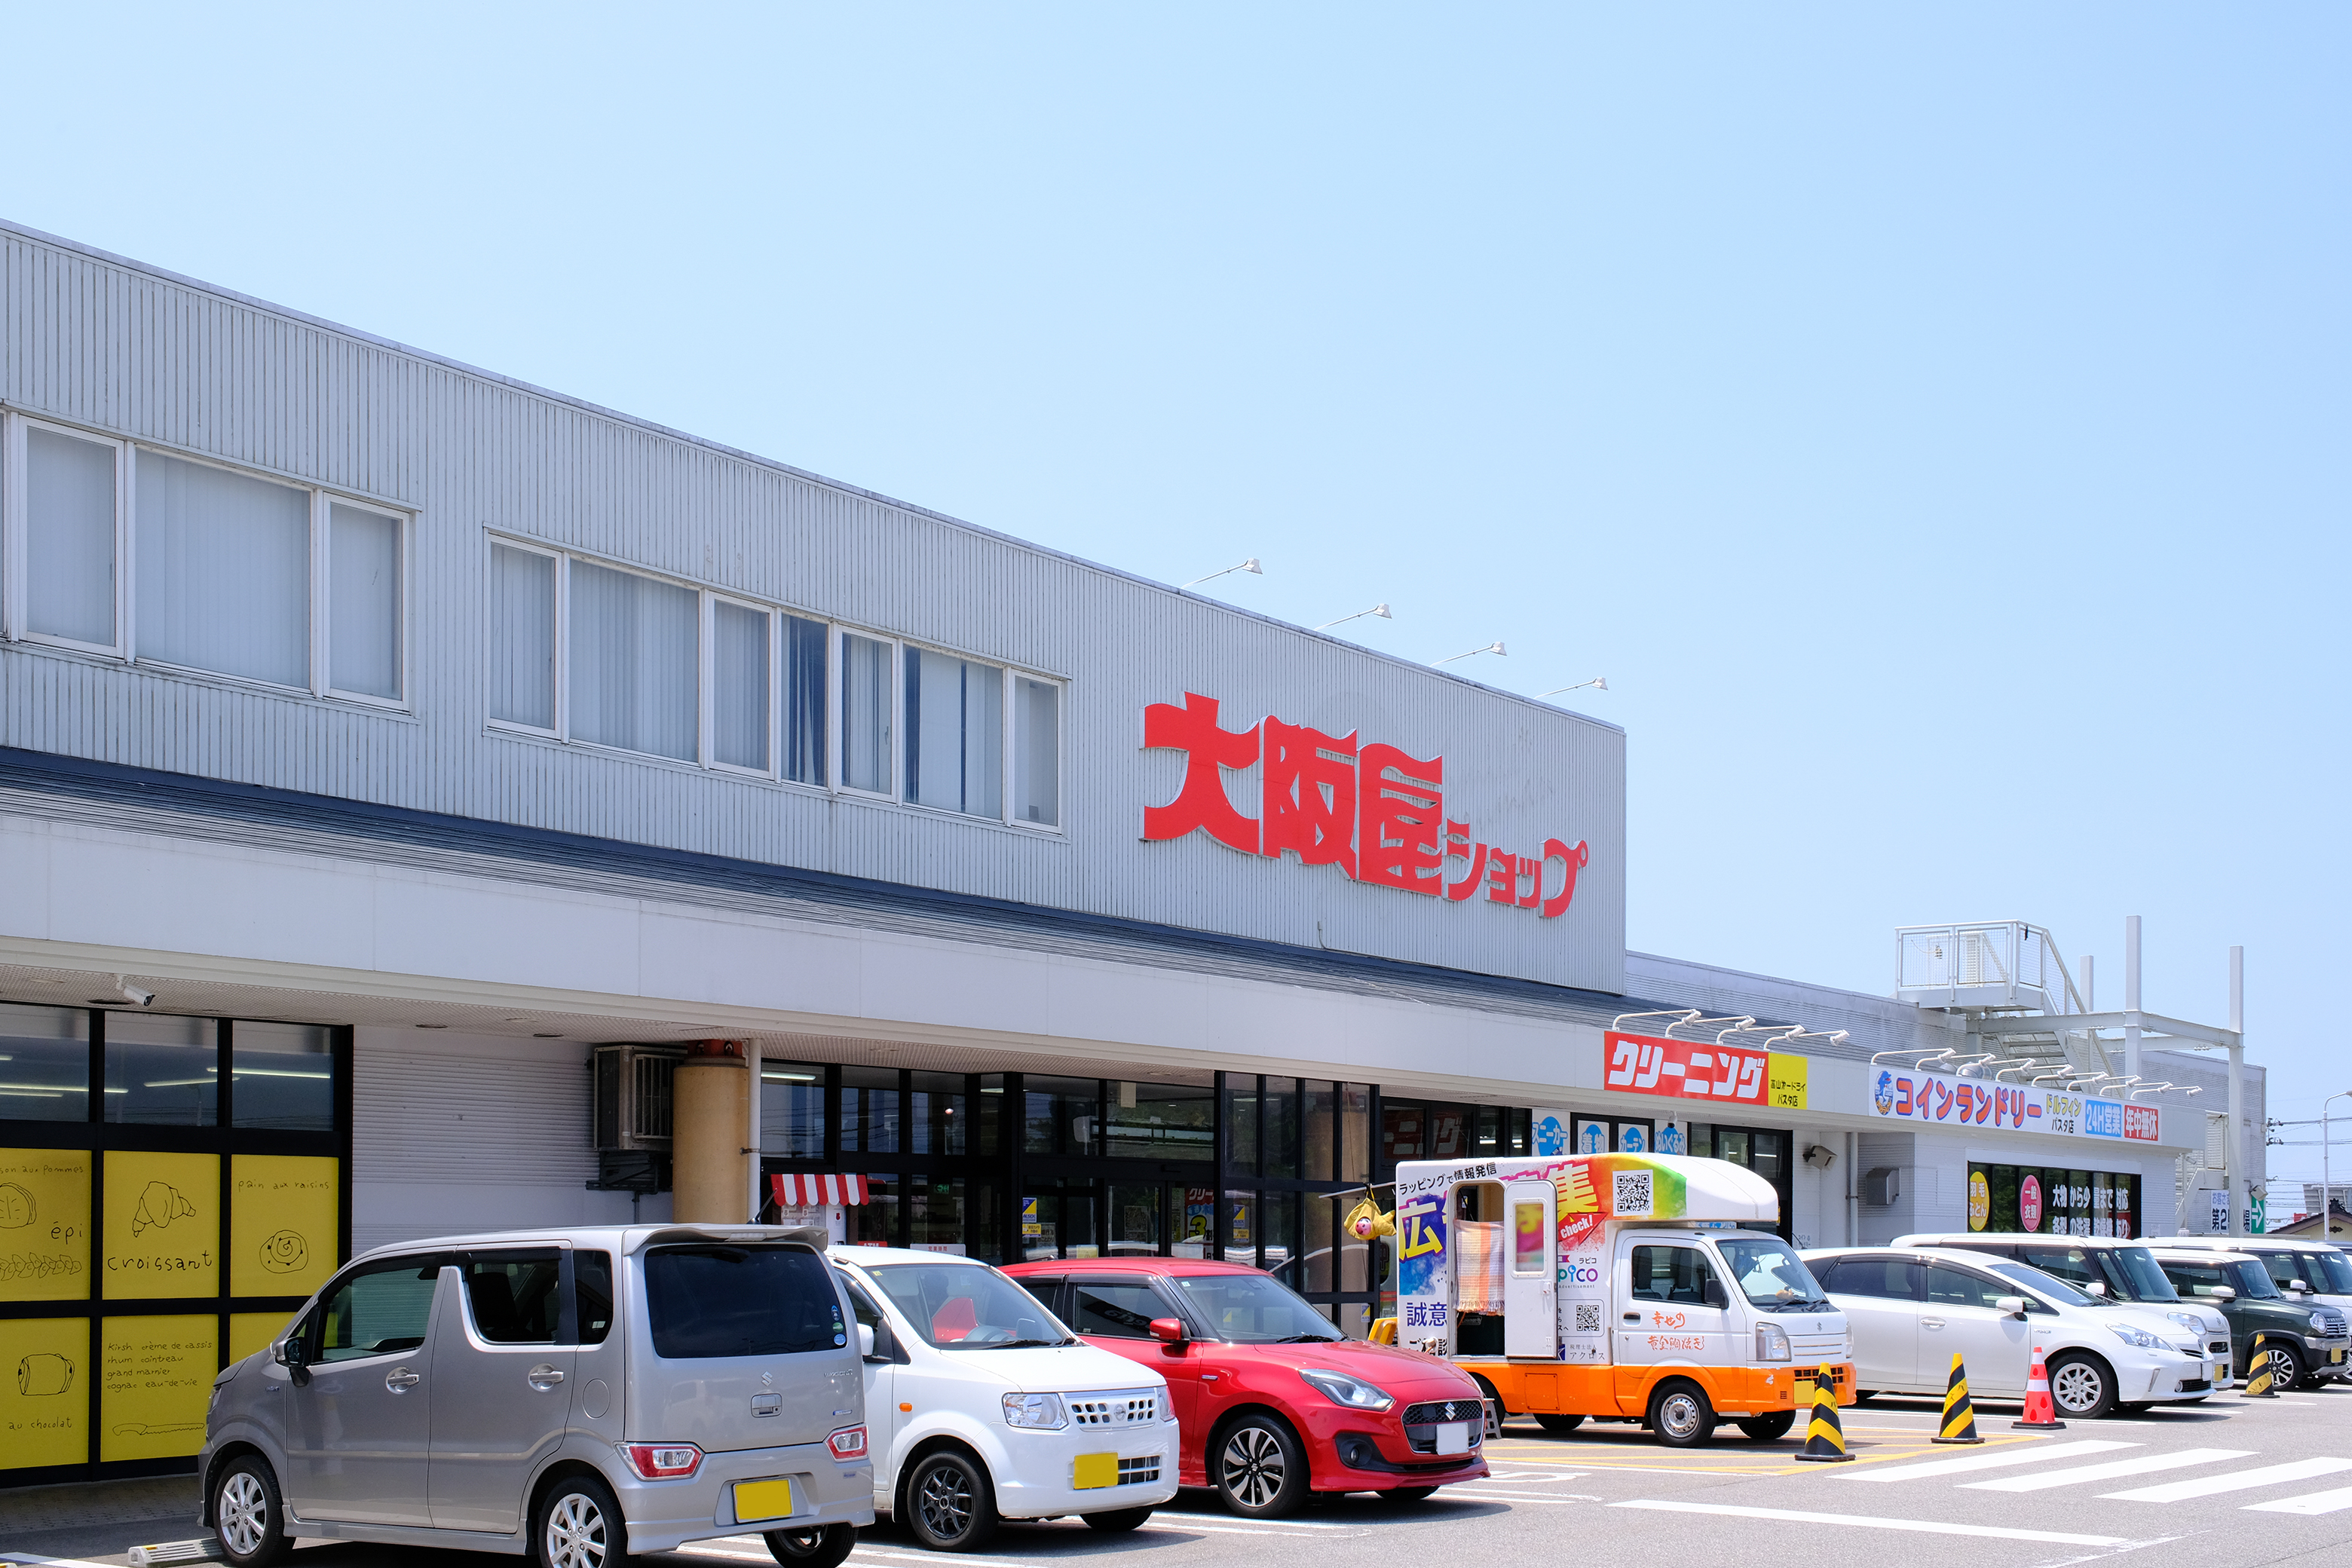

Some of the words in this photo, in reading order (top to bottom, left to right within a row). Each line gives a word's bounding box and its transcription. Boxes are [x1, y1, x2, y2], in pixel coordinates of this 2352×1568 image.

[1143, 691, 1588, 917] 大阪屋ショップ
[1608, 1040, 1766, 1099] クリーニング
[1896, 1076, 2042, 1129] コインランドリー
[2046, 1093, 2081, 1117] ドルフィン
[2086, 1104, 2121, 1135] 24H営業
[2126, 1107, 2157, 1139] 年中無休
[1621, 1134, 1645, 1153] カーテン
[1399, 1162, 1497, 1196] ラッピングで情報発信
[1189, 1188, 1214, 1201] クリー
[51, 1221, 82, 1245] épi
[1560, 1214, 1594, 1240] check!
[108, 1249, 213, 1272] croissant
[185, 1340, 213, 1349] cassis
[1570, 1352, 1605, 1360] アクロス
[107, 1356, 133, 1364] rhum
[141, 1355, 184, 1363] cointreau
[107, 1368, 133, 1381] grand
[107, 1383, 137, 1393] cognac
[145, 1379, 198, 1389] eau-de-vie
[8, 1421, 23, 1430] au
[31, 1416, 72, 1429] chocolat
